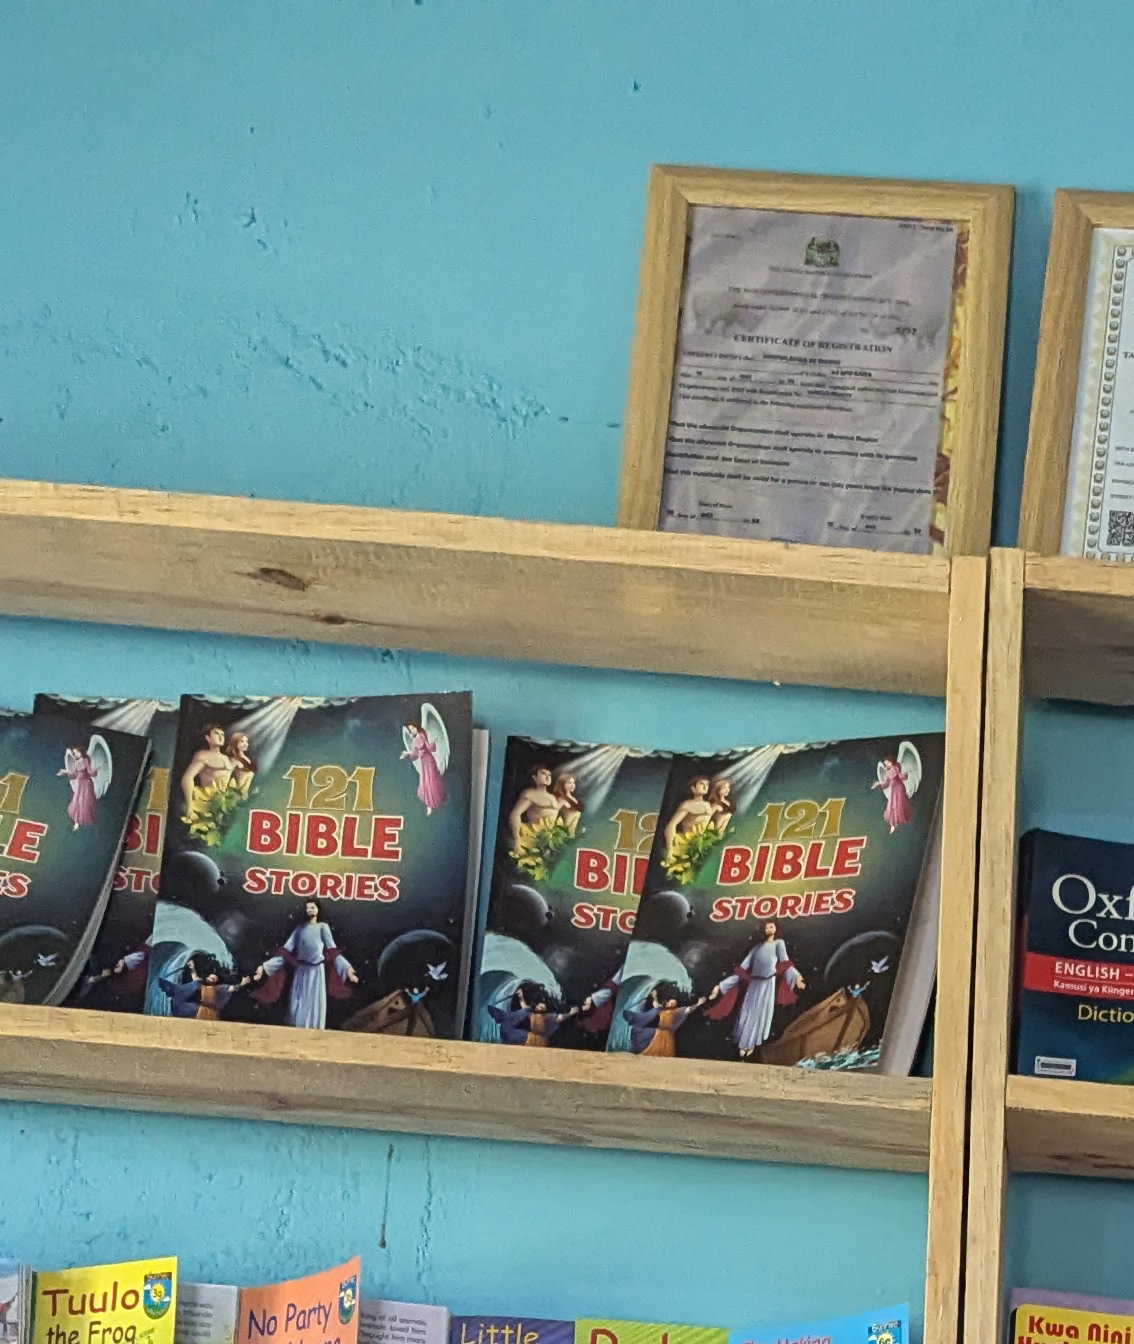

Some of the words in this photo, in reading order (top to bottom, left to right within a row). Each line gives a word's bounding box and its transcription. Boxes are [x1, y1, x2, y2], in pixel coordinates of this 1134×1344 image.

[284, 764, 375, 811] 121
[246, 810, 402, 861] BIBLE
[758, 798, 847, 842] 121
[717, 837, 866, 885] BIBLE
[243, 867, 400, 902] STORIES
[710, 889, 855, 922] STORIES
[1053, 979, 1086, 993] Kamusi
[1089, 985, 1099, 997] ya
[1055, 962, 1120, 981] ENGLISH
[42, 1281, 140, 1316] Tuulo
[248, 1309, 276, 1340] No
[285, 1300, 332, 1335] Party
[1029, 1316, 1079, 1339] Kwa
